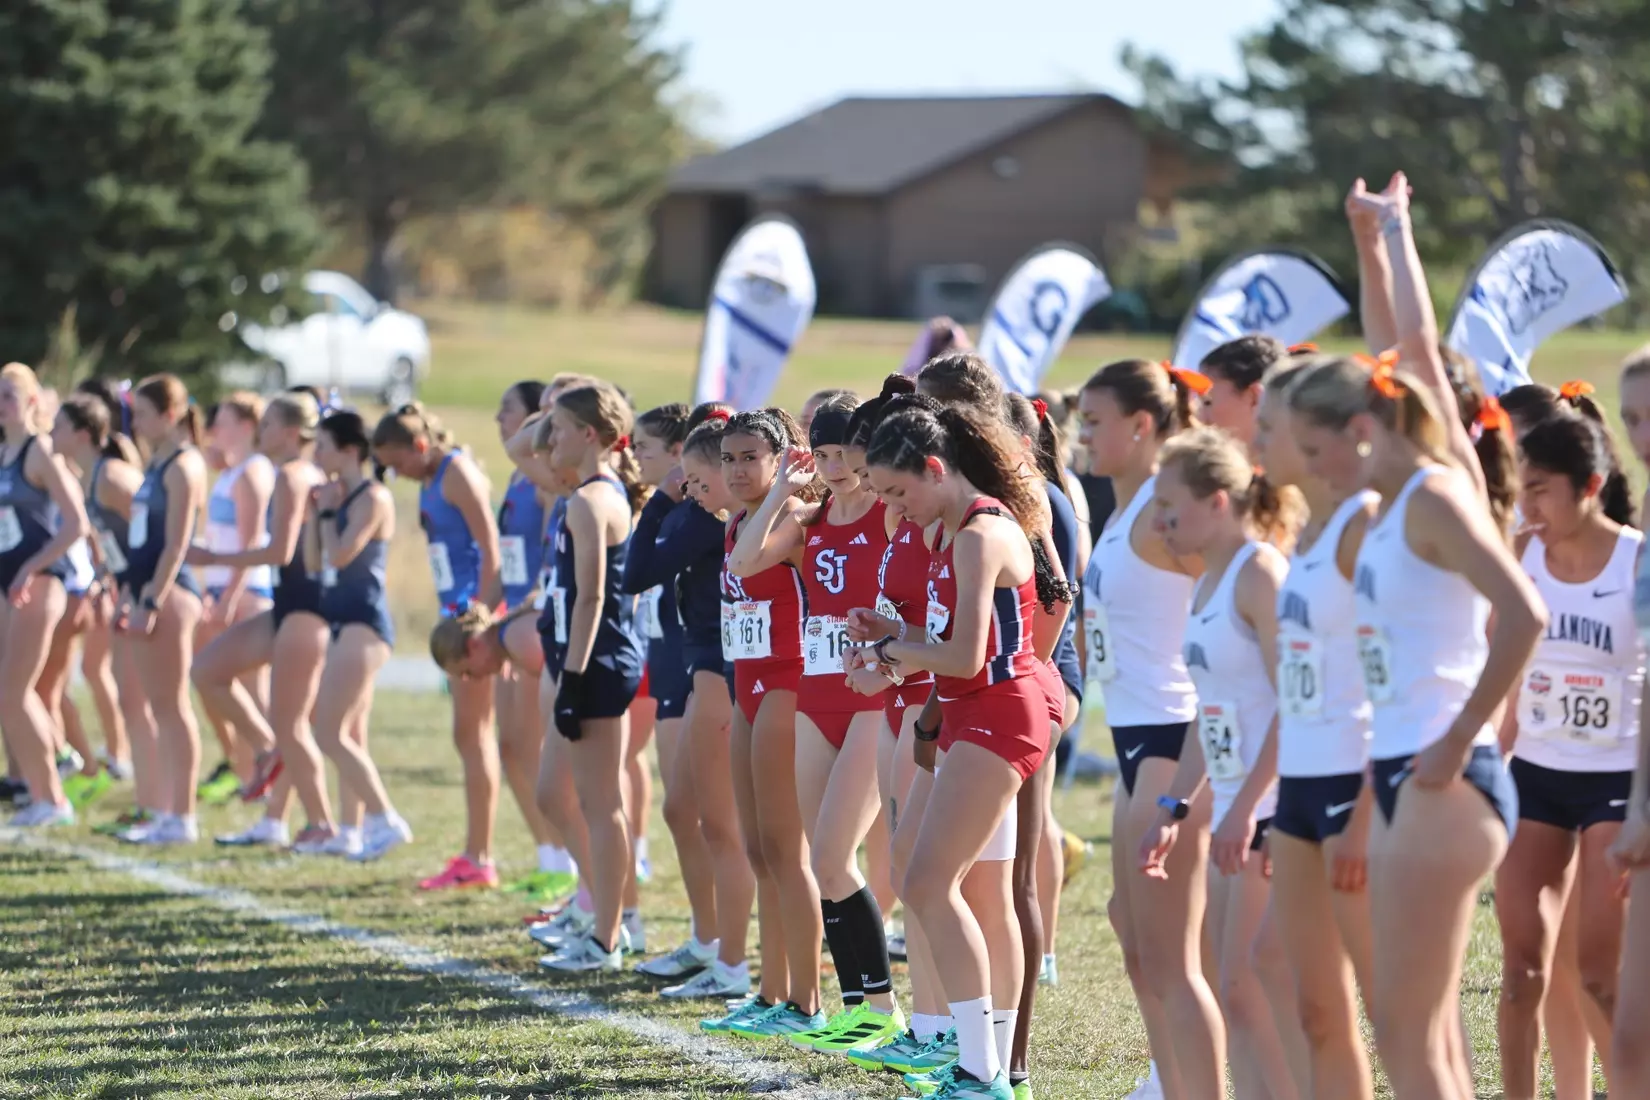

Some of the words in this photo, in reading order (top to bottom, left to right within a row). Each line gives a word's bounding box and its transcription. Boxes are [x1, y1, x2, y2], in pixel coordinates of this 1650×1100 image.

[739, 617, 763, 644] 161
[826, 630, 866, 658] 16
[1543, 612, 1614, 654] LANOVA
[1560, 695, 1609, 729] 163
